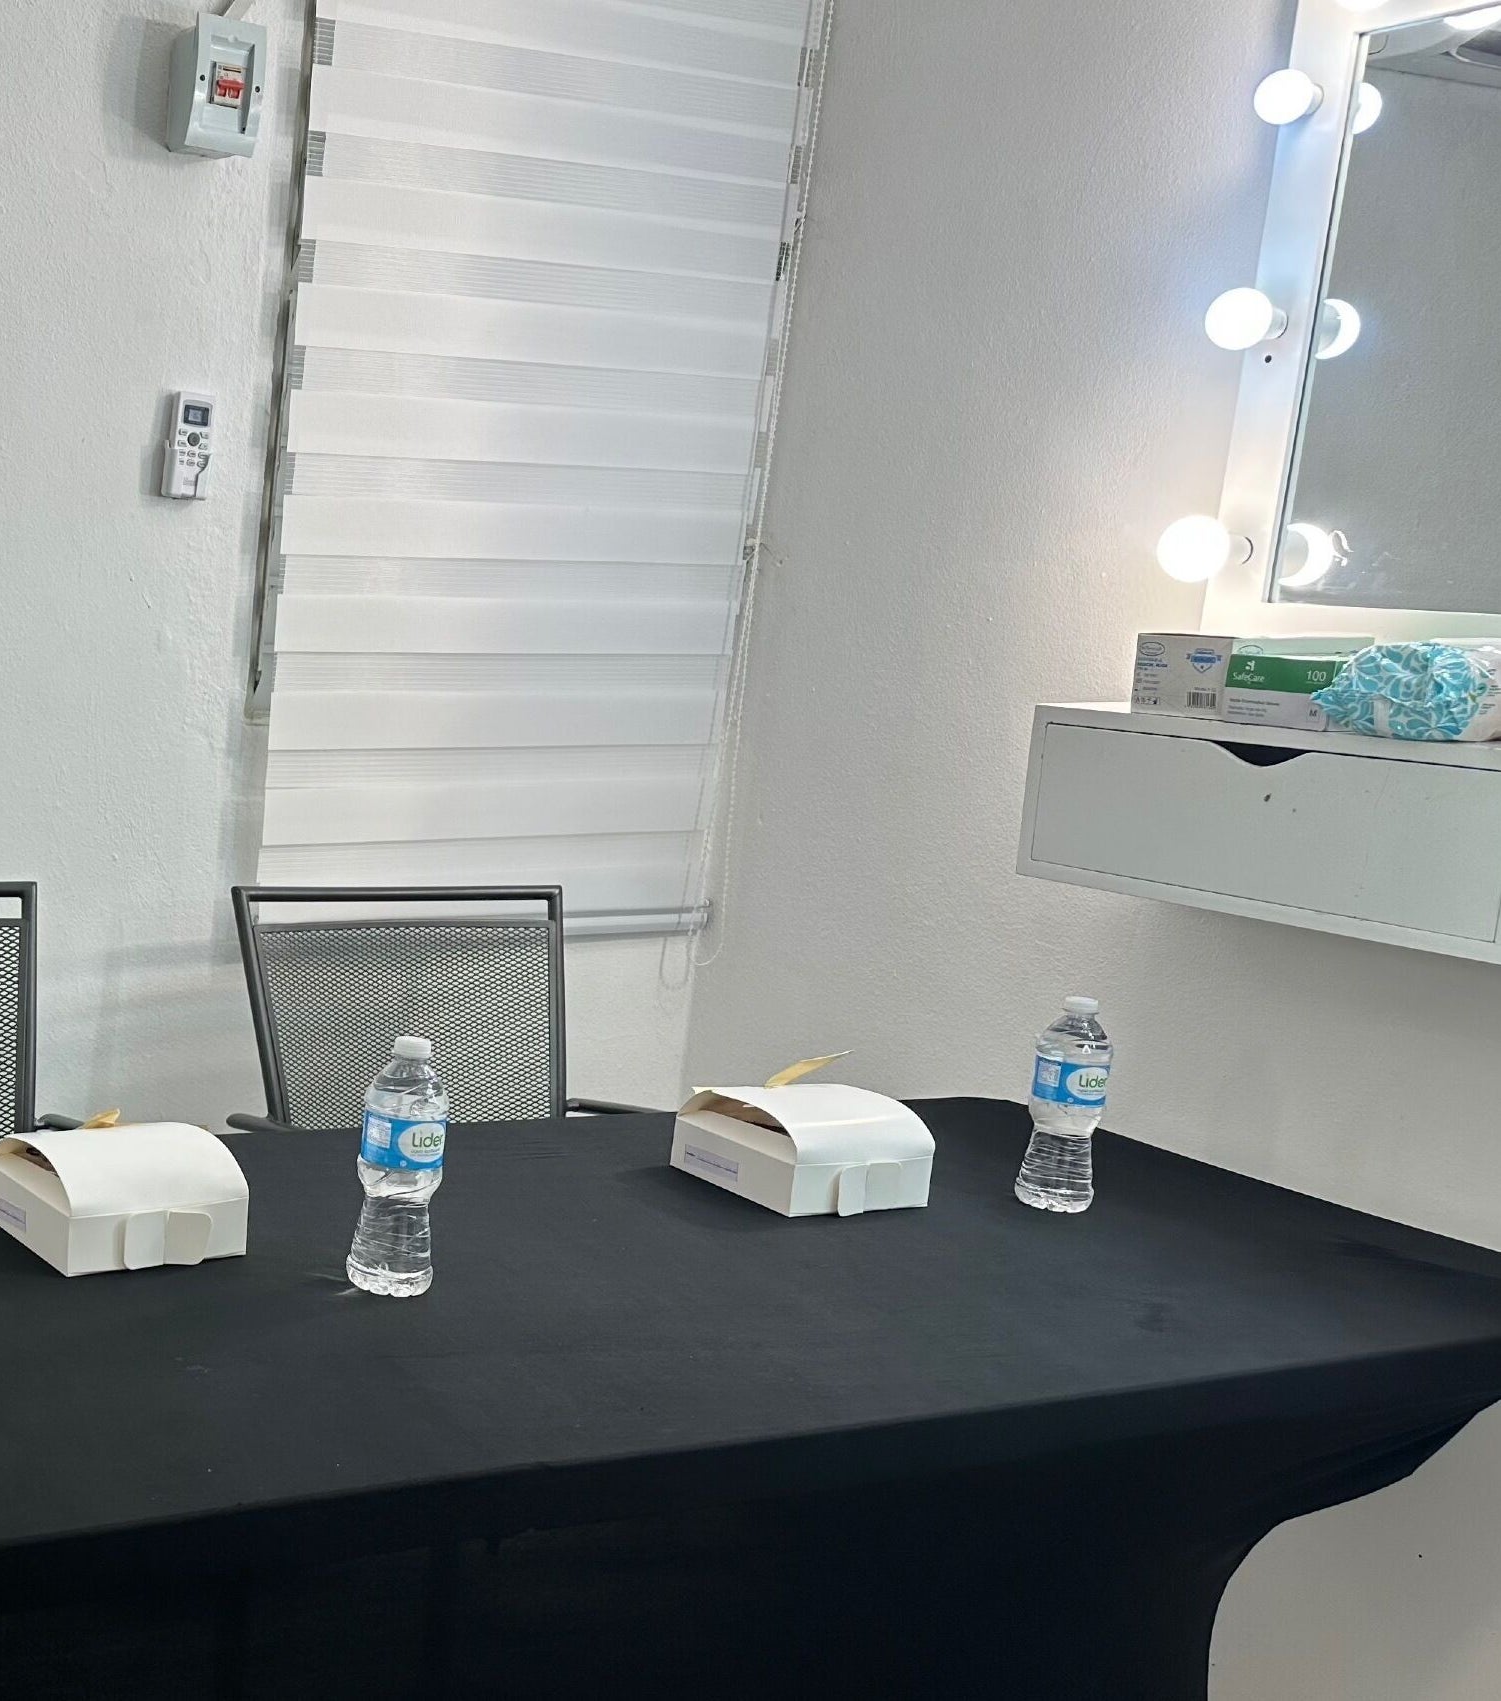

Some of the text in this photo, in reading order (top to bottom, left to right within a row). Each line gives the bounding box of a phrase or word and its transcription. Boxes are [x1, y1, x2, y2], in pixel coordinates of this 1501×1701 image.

[1232, 671, 1265, 684] SafeCare
[1306, 670, 1327, 681] 100
[1309, 709, 1318, 717] M
[412, 1130, 443, 1147] Lider
